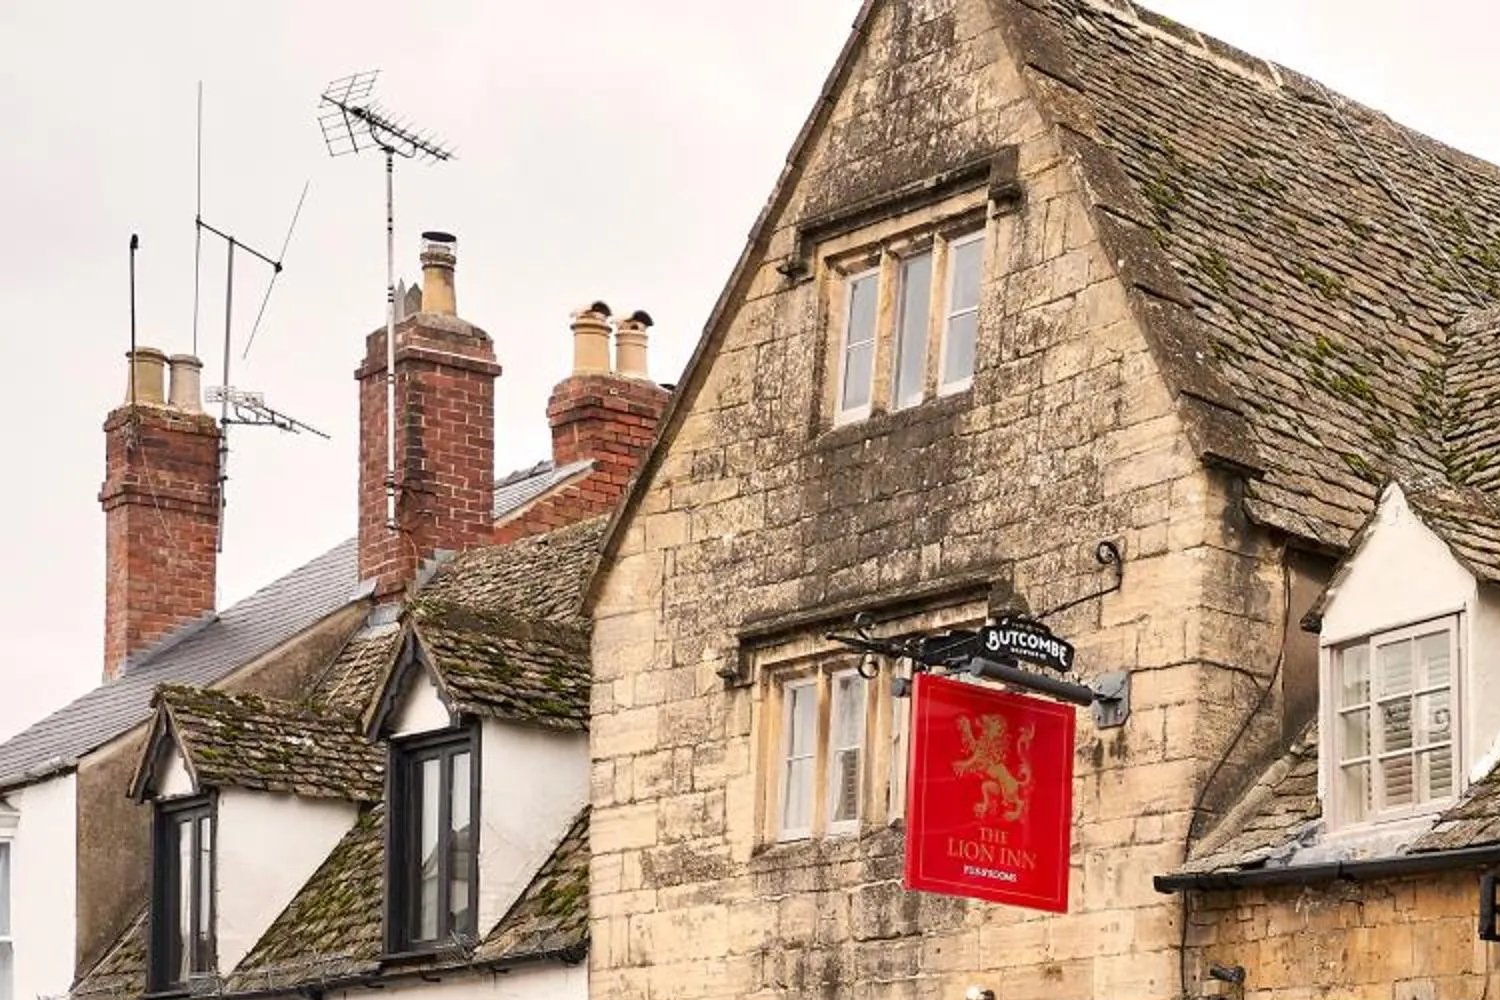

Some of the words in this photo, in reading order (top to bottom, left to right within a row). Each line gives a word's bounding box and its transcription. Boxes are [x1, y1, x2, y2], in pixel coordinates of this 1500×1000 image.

[985, 629, 1067, 667] BUTCOMBE
[979, 827, 1009, 844] THE
[947, 837, 995, 862] LION
[1000, 847, 1037, 870] INN
